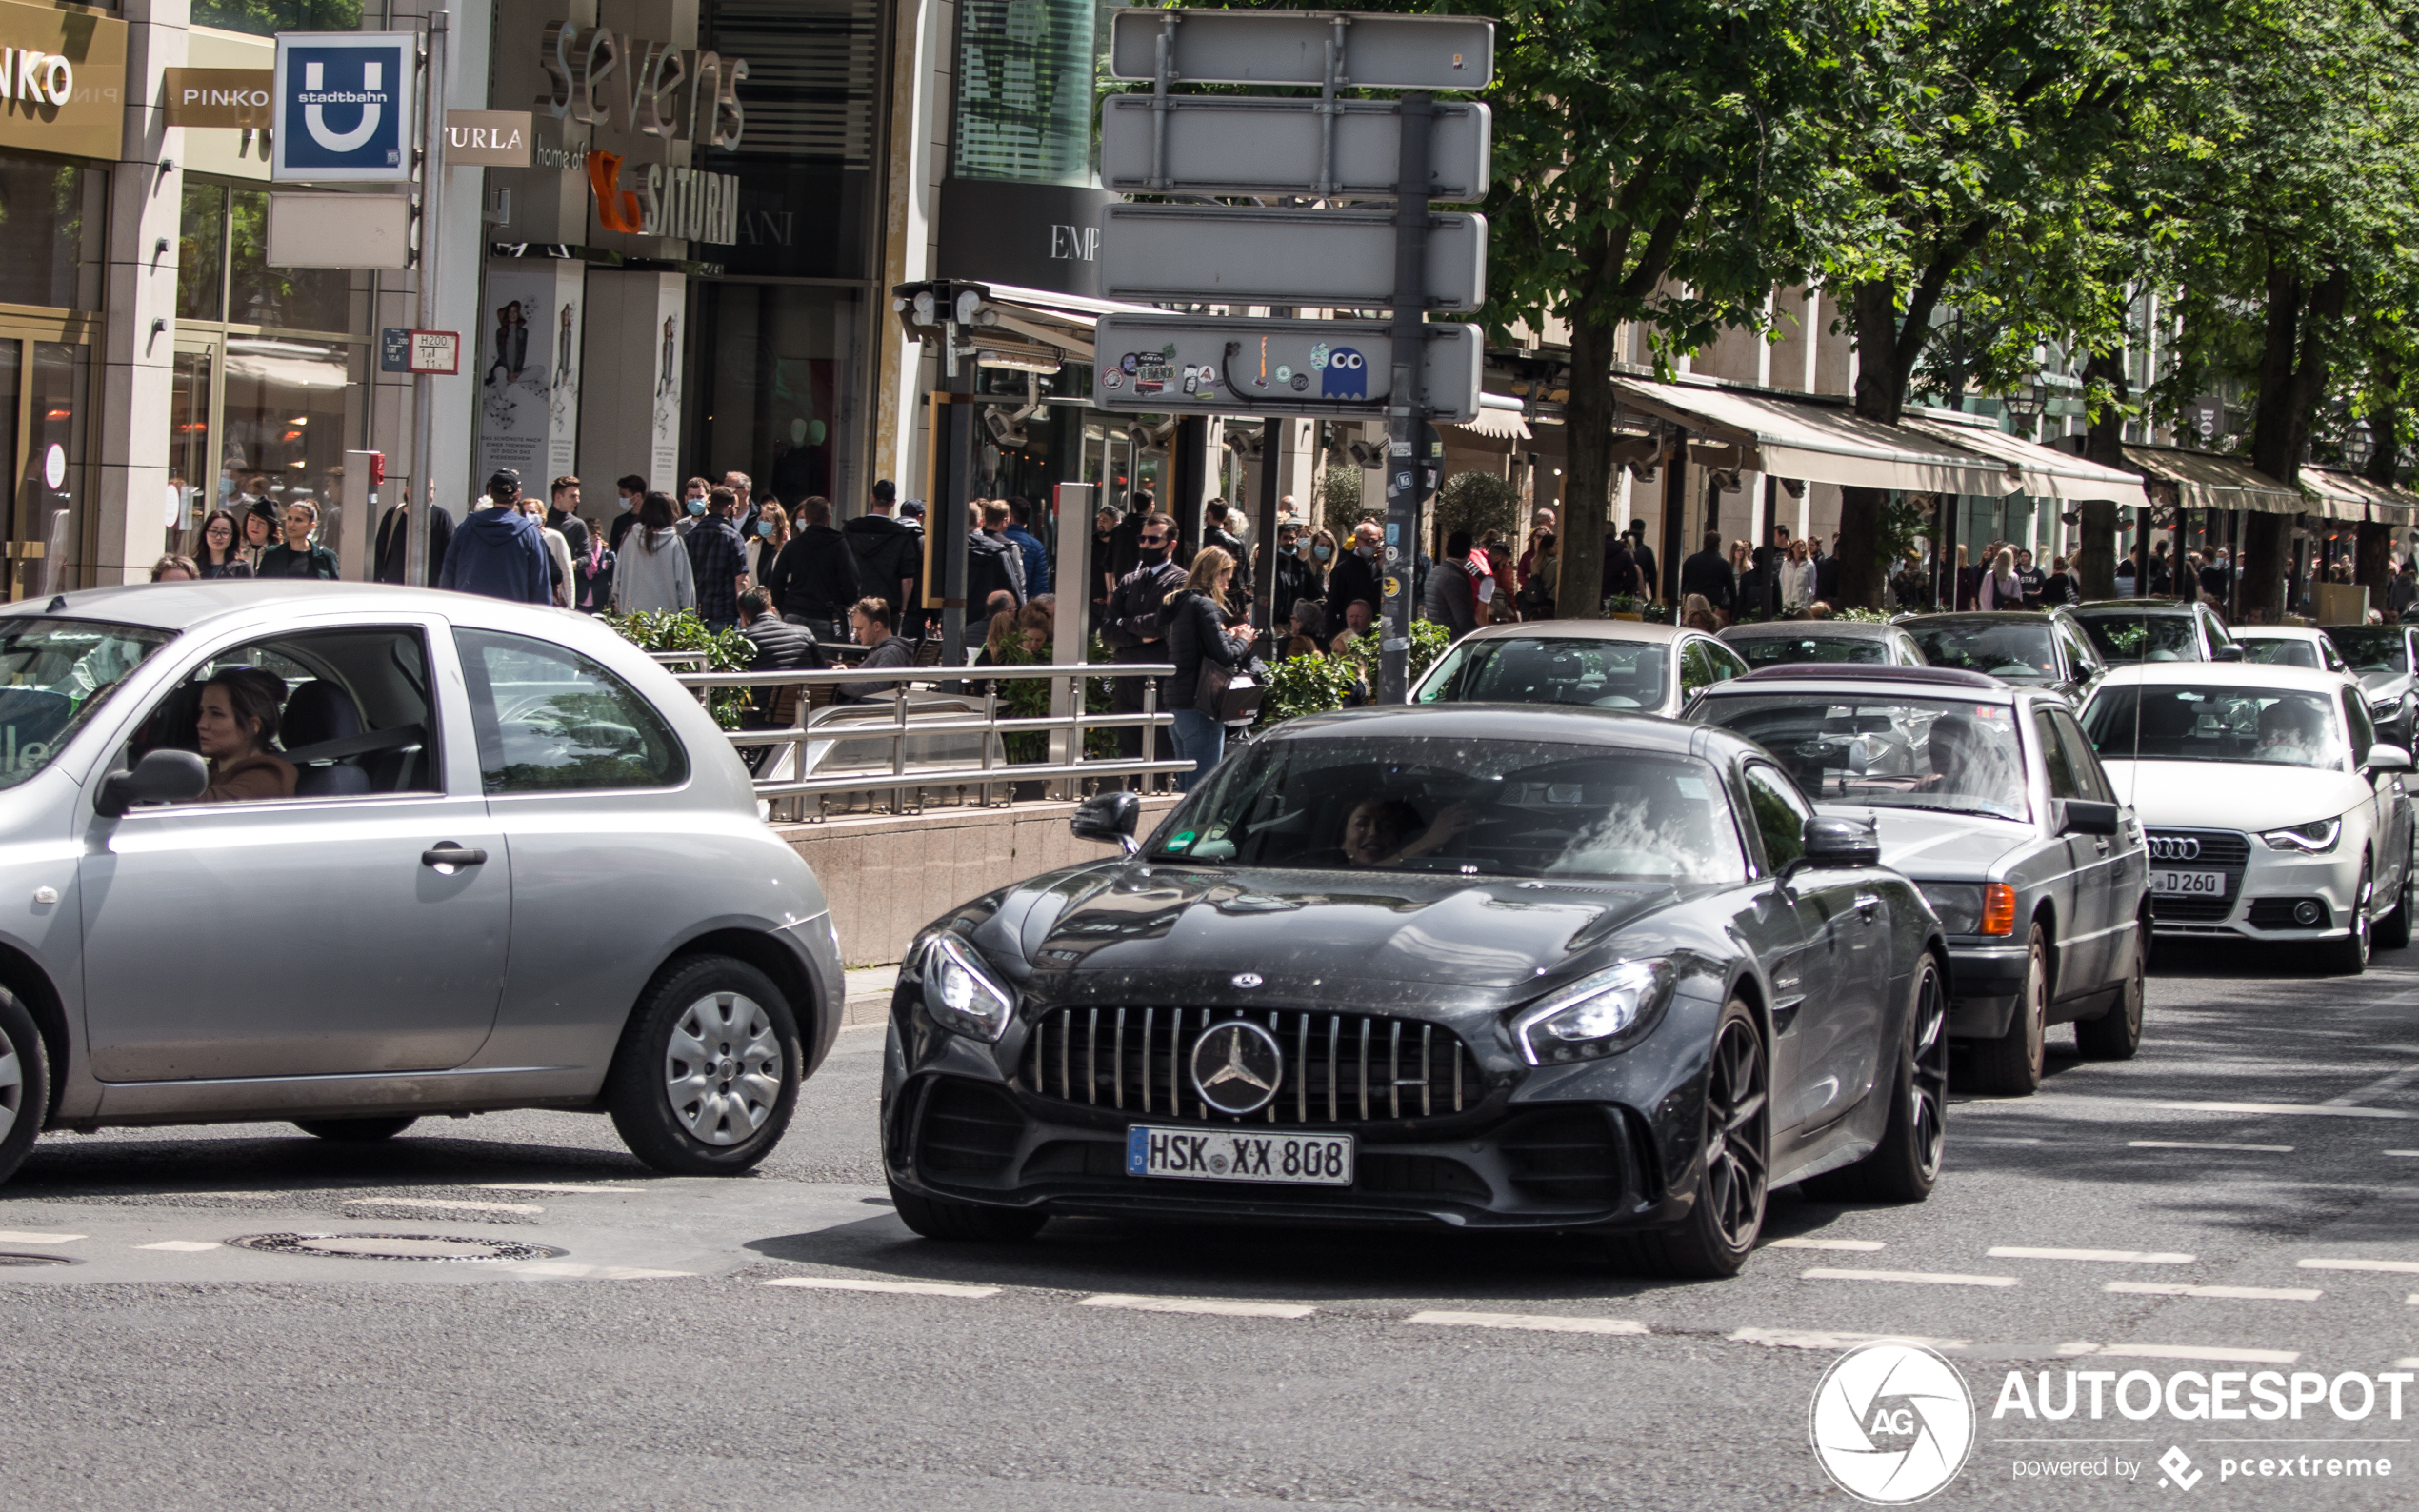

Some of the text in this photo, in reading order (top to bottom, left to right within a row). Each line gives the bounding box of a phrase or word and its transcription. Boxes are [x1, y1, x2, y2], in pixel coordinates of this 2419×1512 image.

[534, 20, 750, 151] sevens
[183, 89, 270, 107] PINKO
[298, 91, 388, 103] stadtbahn
[445, 127, 523, 149] URLA
[536, 134, 585, 169] home of
[645, 163, 739, 246] SATURN
[421, 336, 447, 346] H200
[2182, 874, 2216, 892] 260
[1150, 1134, 1209, 1172] HSK
[1231, 1138, 1272, 1176] XX
[1283, 1140, 1343, 1178] 808
